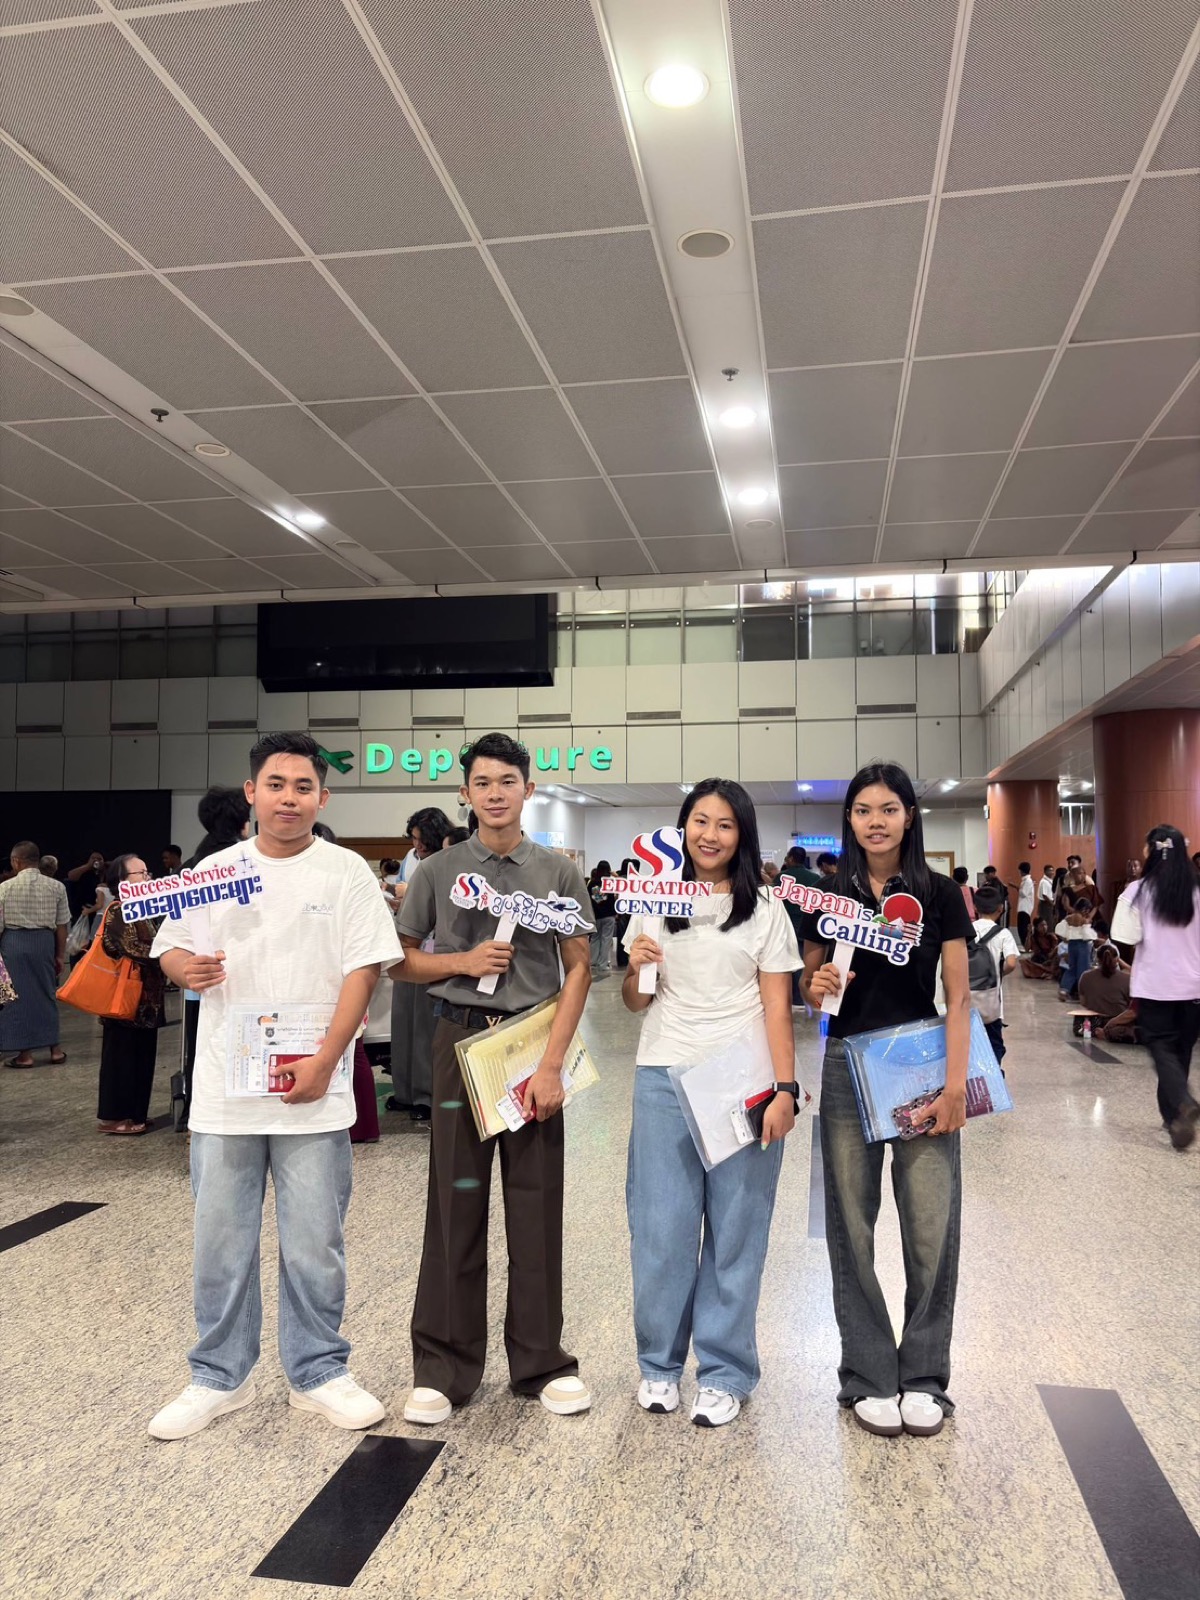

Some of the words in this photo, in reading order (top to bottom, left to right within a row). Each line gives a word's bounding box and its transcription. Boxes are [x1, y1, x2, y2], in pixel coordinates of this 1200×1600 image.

[365, 742, 614, 781] Depure
[119, 874, 180, 900] Success
[181, 864, 237, 887] Service
[601, 878, 712, 897] EDUCATION
[773, 875, 856, 920] Japan
[857, 905, 874, 922] is
[615, 899, 694, 917] CENTER
[820, 916, 910, 963] Calling
